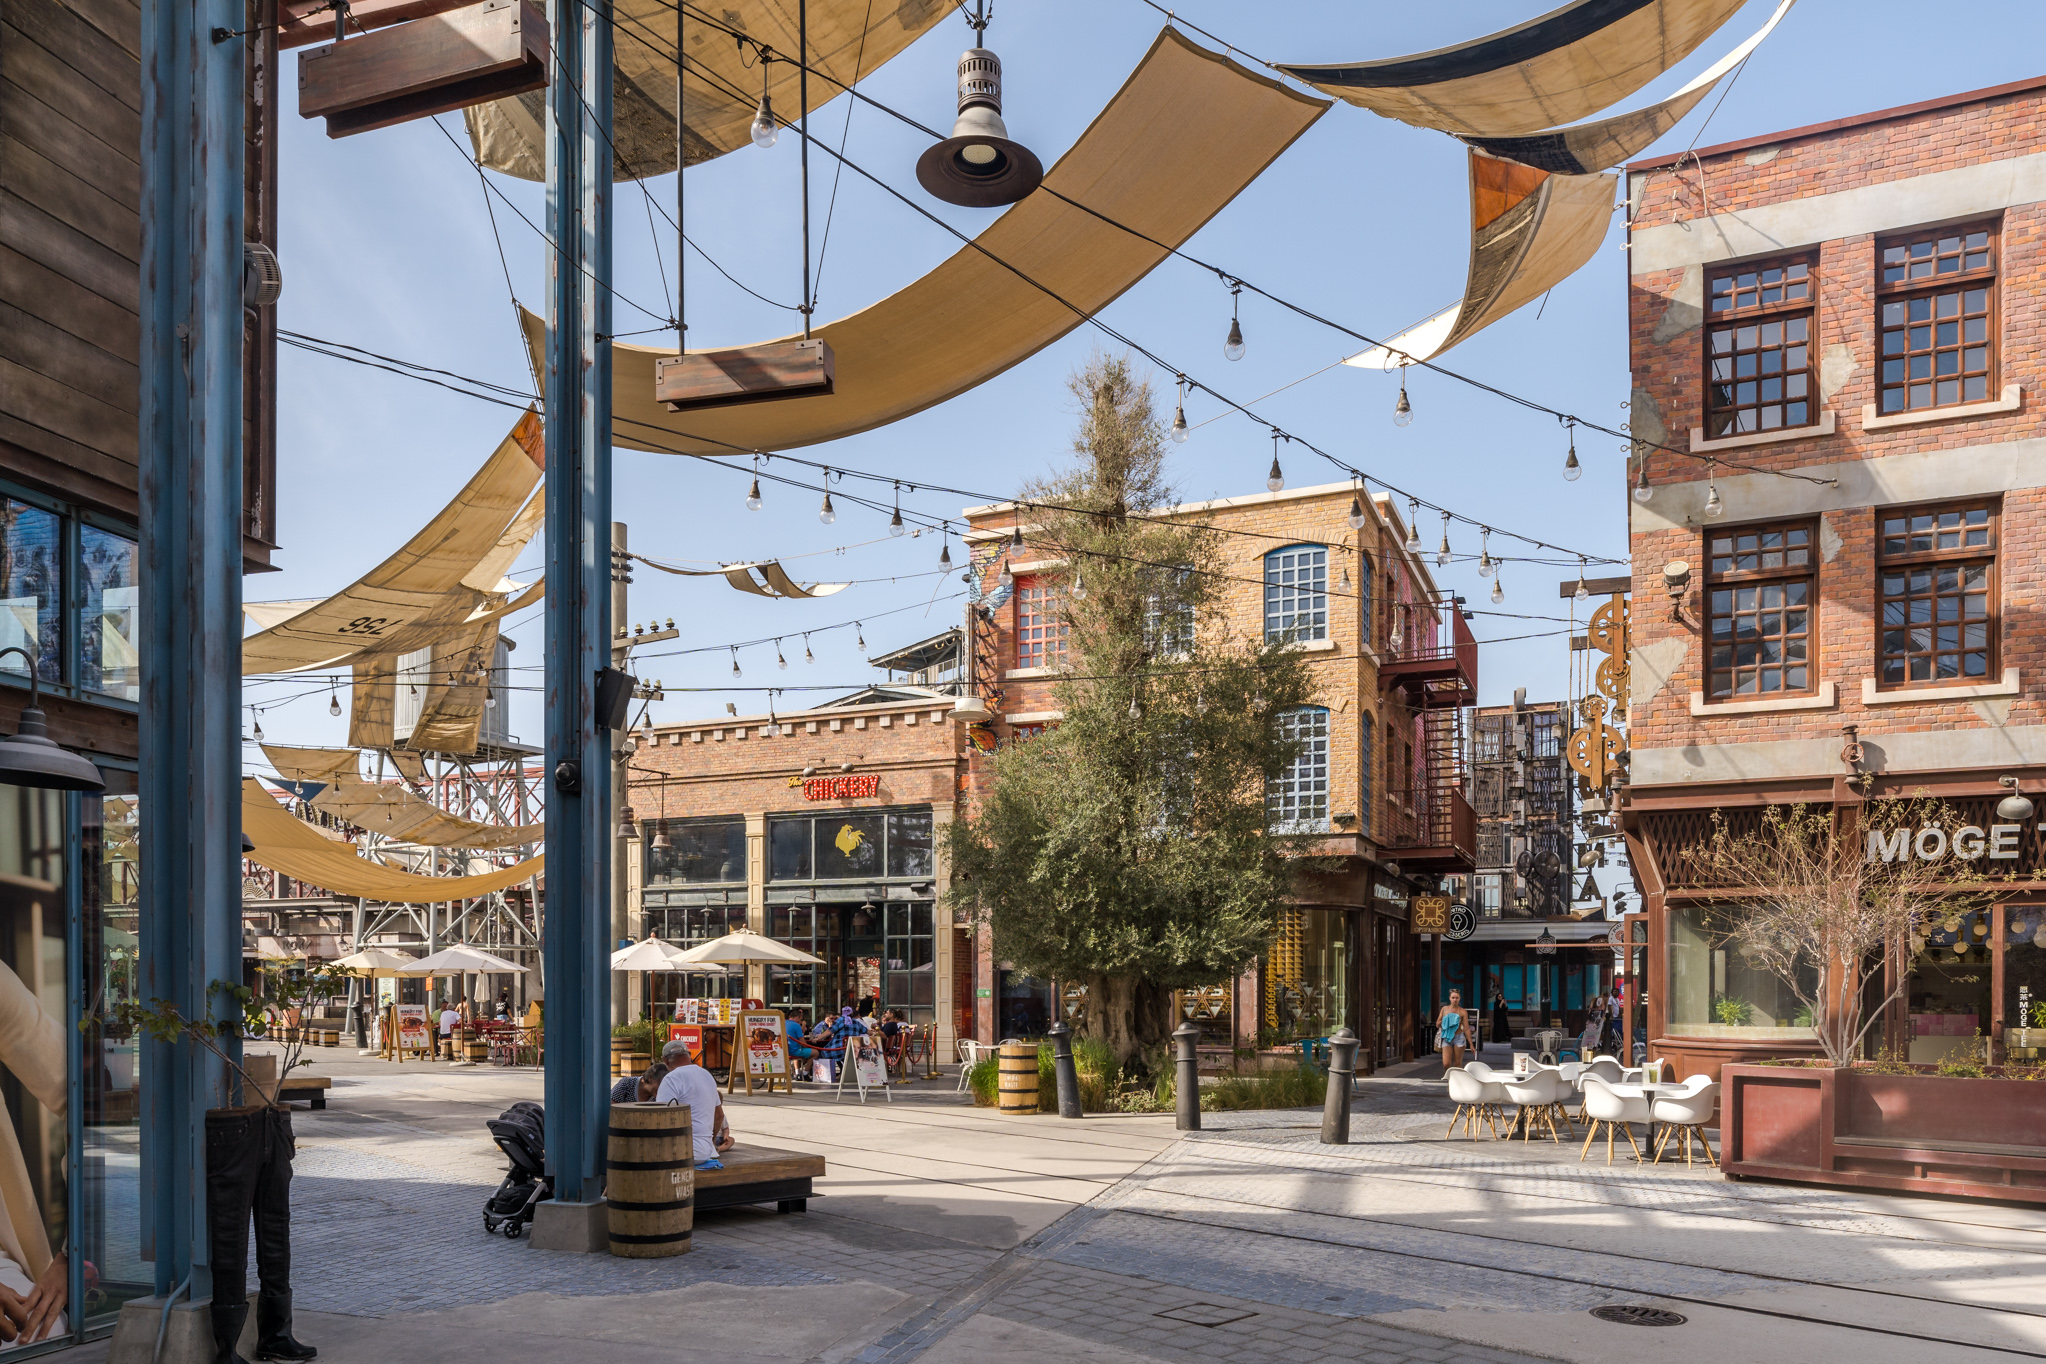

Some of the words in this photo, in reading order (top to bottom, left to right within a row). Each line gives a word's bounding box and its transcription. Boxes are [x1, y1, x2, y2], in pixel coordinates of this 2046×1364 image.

[786, 775, 804, 787] The
[804, 774, 880, 800] CHICKERY
[1866, 820, 2021, 863] MÖGE
